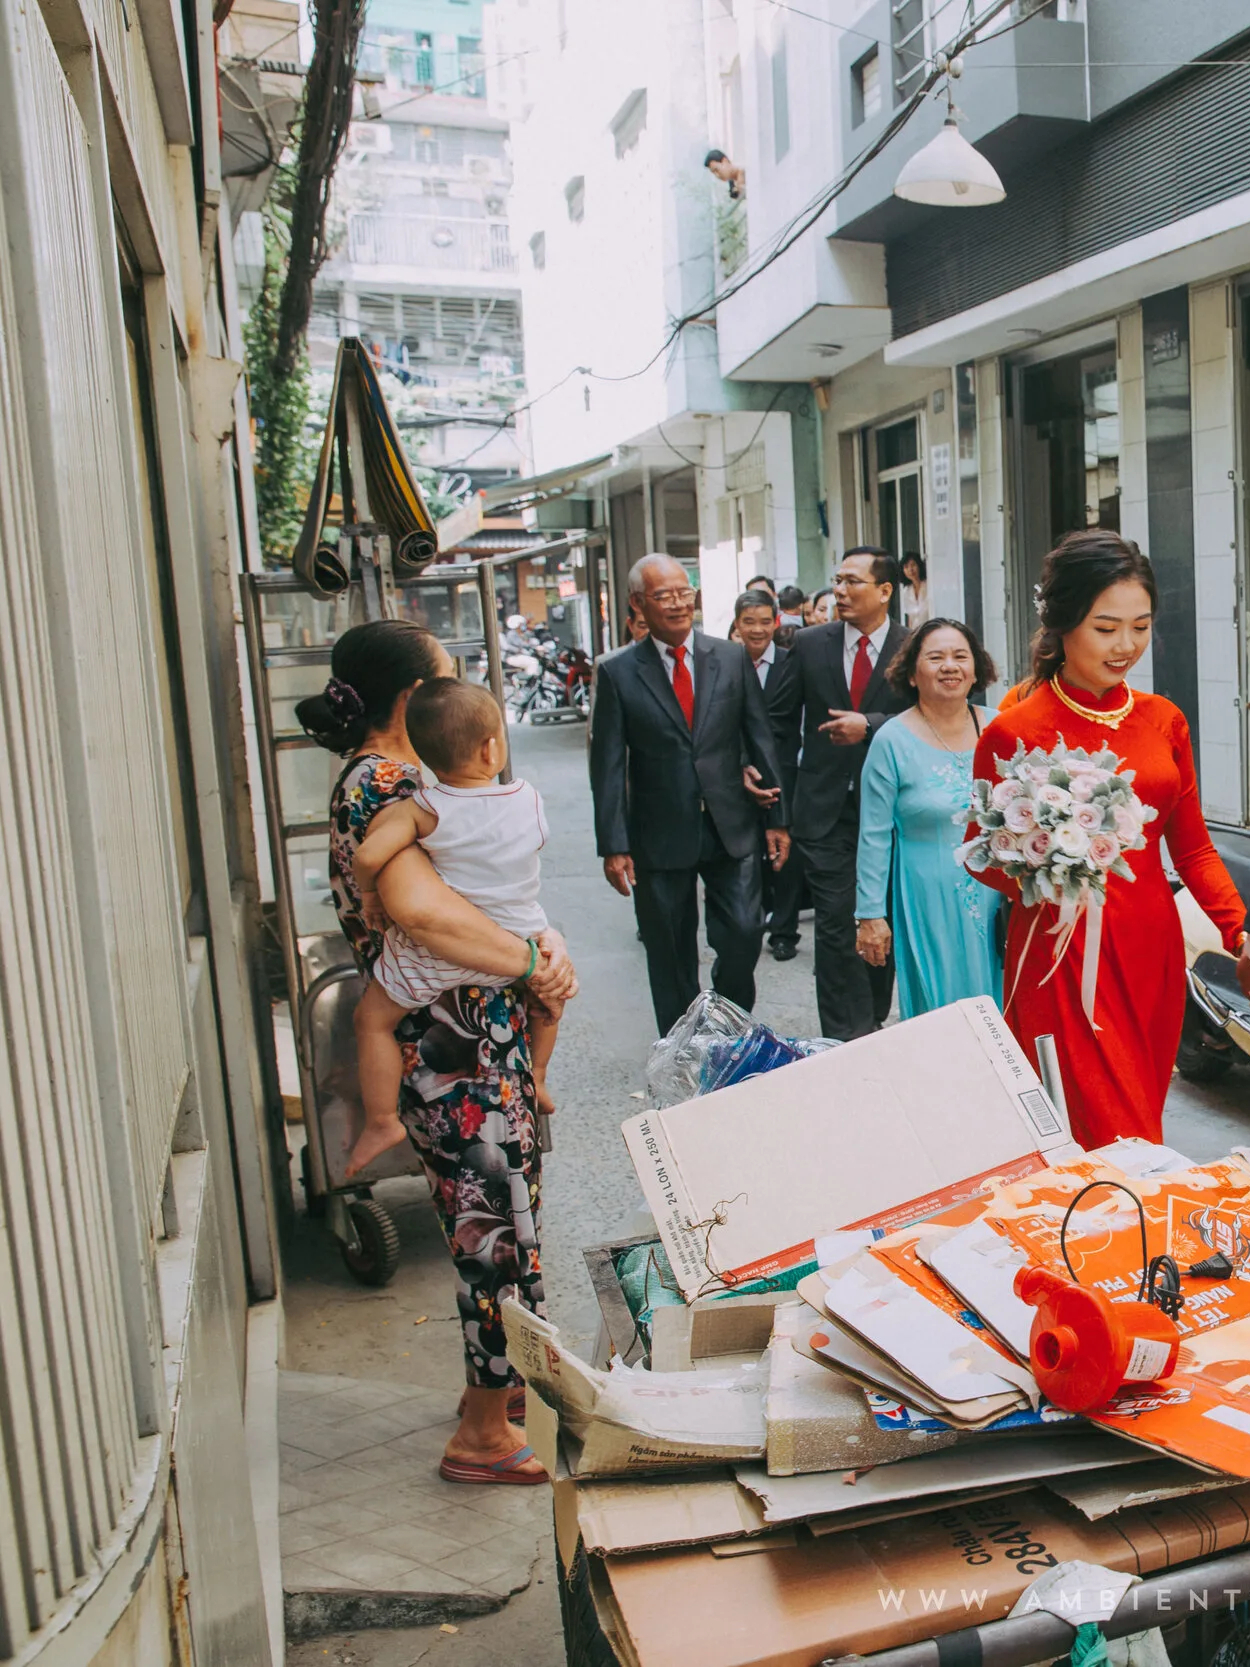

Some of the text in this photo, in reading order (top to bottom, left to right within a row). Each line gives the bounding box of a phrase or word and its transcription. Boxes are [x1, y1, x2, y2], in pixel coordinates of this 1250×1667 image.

[983, 1016, 1001, 1039] CANS
[1001, 1049, 1015, 1064] 250
[1011, 1066, 1022, 1079] ML
[640, 1119, 651, 1136] ML
[645, 1138, 659, 1156] 250
[656, 1167, 671, 1190] LON
[665, 1192, 677, 1205] 24
[1093, 1276, 1128, 1293] PH
[1185, 1285, 1234, 1317] NĂNG
[1193, 1300, 1229, 1335] TẾT
[952, 1529, 993, 1565] Chậu
